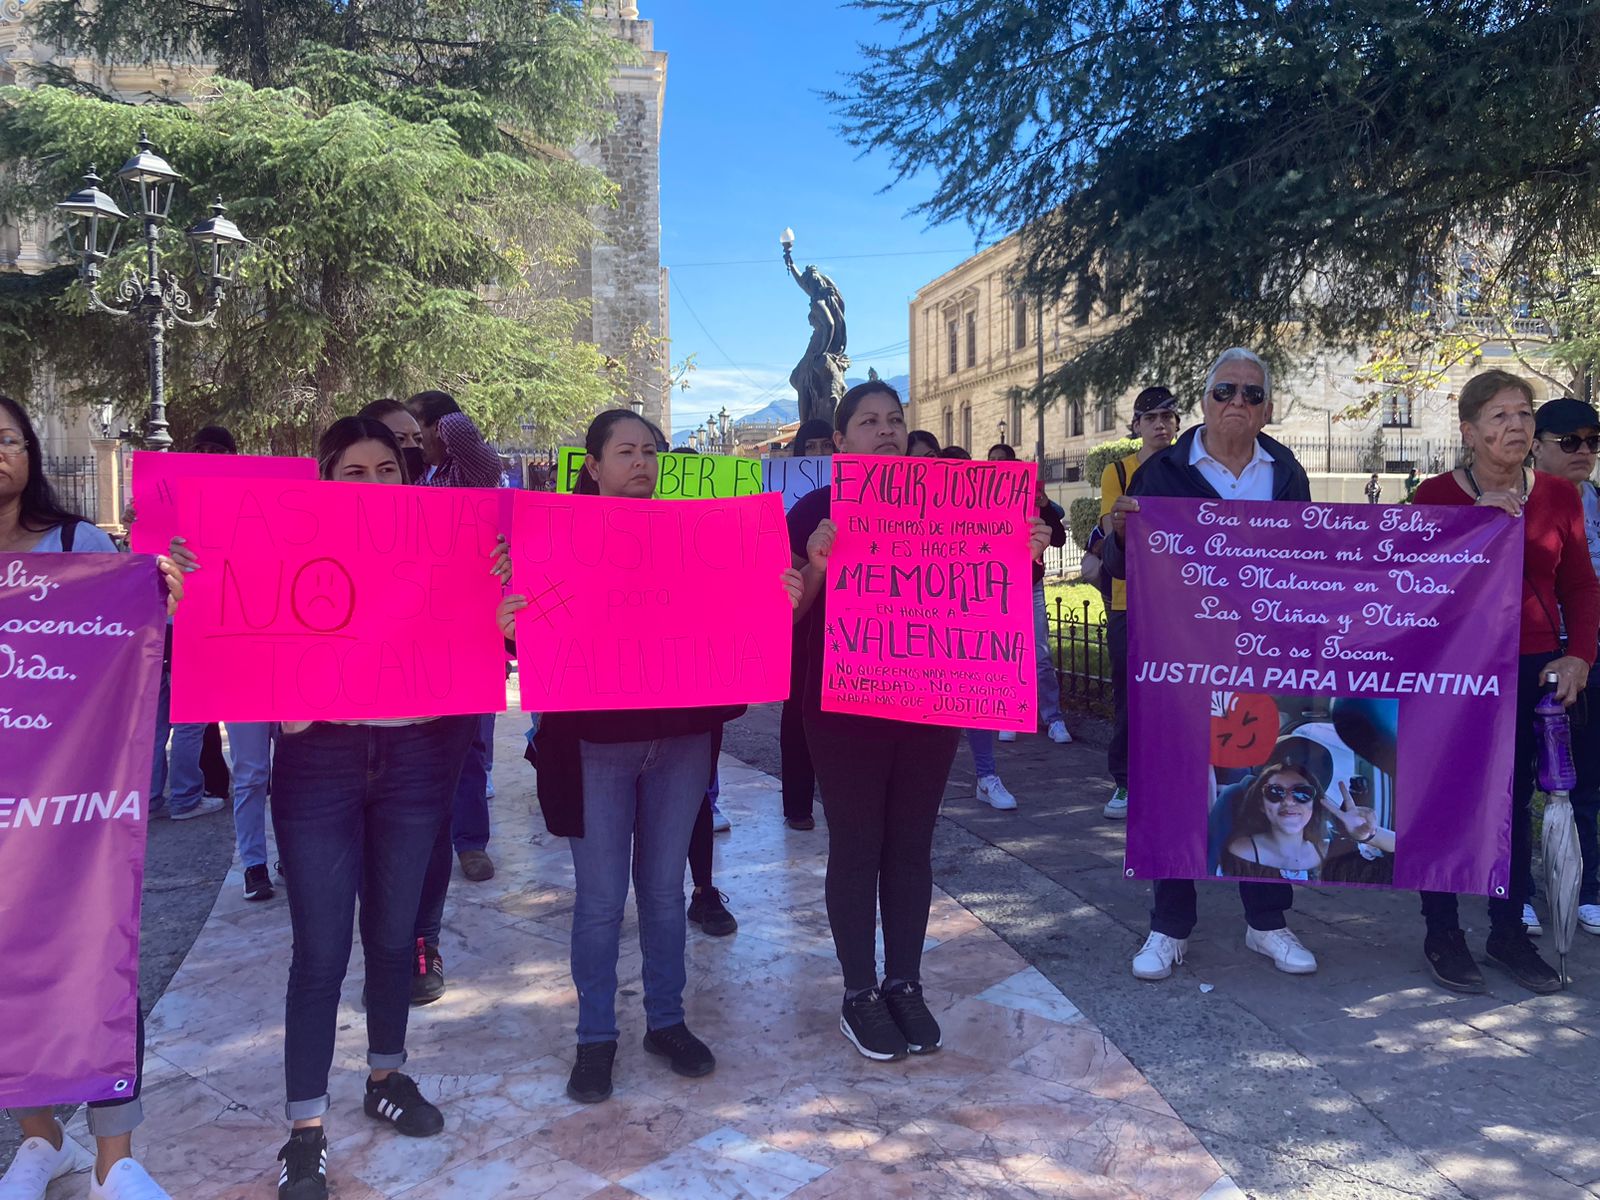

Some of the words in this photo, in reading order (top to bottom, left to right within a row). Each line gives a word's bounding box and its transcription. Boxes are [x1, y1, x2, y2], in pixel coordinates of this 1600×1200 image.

[832, 460, 928, 519] EXIGIR
[933, 461, 1031, 523] JUSTICIA
[199, 489, 319, 551] LAS
[522, 502, 788, 572] JUSTICIA
[849, 516, 869, 533] EN
[876, 518, 925, 535] TIEMPOS
[930, 521, 944, 535] DE
[951, 520, 1014, 536] IMPUNIDAD
[1196, 502, 1241, 526] Era
[1249, 515, 1292, 529] una
[1301, 505, 1370, 531] Niña
[1379, 508, 1442, 541] Feliz.
[892, 540, 912, 557] ES
[921, 541, 969, 559] HACER
[1148, 530, 1196, 555] Me
[1204, 532, 1328, 560] Arrancaron
[1335, 547, 1363, 562] mi
[1373, 538, 1491, 564] Inocencia.
[220, 556, 357, 632] NO
[387, 560, 455, 621] SE
[834, 561, 1014, 614] MEMORIA
[1181, 562, 1230, 587] Me
[1238, 564, 1346, 592] Mataron
[1353, 580, 1379, 593] en
[1388, 568, 1456, 595] Vida.
[608, 588, 669, 622] para
[876, 604, 894, 615] EN
[900, 607, 939, 619] HONOR
[947, 608, 956, 618] A
[1194, 596, 1242, 621] Las
[1251, 598, 1329, 624] Niñas
[1336, 613, 1353, 634] y
[1362, 602, 1440, 627] Niños
[523, 631, 768, 697] VALENTINA
[838, 617, 1030, 685] VALENTINA
[1234, 632, 1282, 657] No
[1289, 646, 1312, 658] se
[1321, 635, 1395, 661] Tocan.
[250, 639, 453, 711] TOCAN
[829, 673, 847, 690] LA
[930, 679, 951, 694] NO
[959, 682, 1017, 699] EXIGIMOS
[836, 658, 853, 676] NO
[857, 664, 920, 680] QUEREMOS
[922, 667, 947, 679] NADA
[951, 670, 982, 682] MENOS
[985, 672, 1009, 684] QUE
[1135, 661, 1255, 687] JUSTICIA
[1262, 667, 1337, 690] PARA
[1347, 670, 1500, 697] VALENTINA
[837, 693, 870, 705] NADA
[875, 695, 896, 706] MAS
[900, 696, 924, 708] QUE
[933, 694, 1008, 717] JUSTICIA
